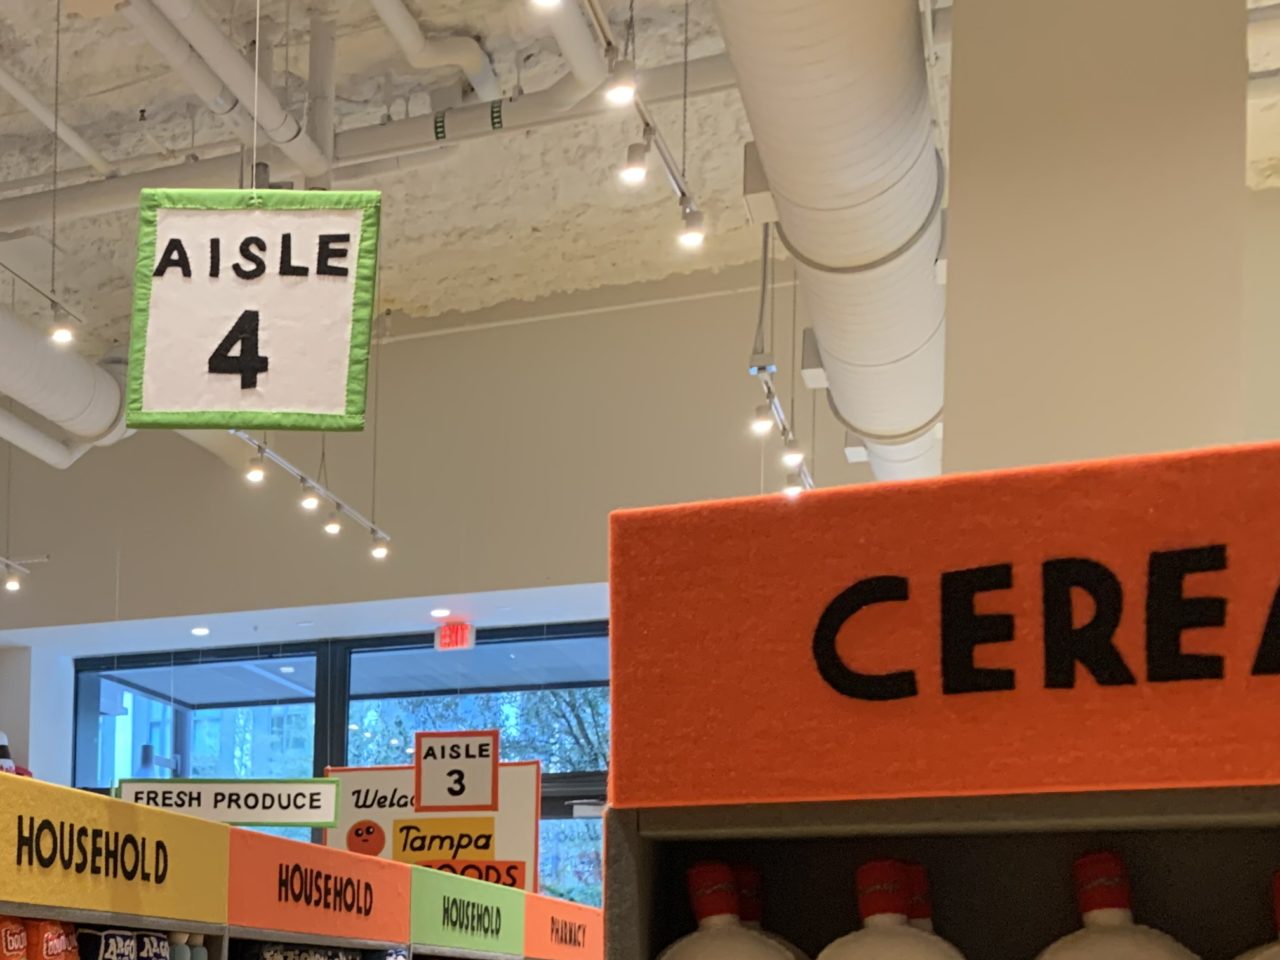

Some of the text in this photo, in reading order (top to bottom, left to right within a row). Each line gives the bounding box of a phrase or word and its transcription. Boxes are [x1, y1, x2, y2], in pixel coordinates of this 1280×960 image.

[153, 233, 350, 280] AISLE
[208, 309, 269, 390] 4
[439, 623, 470, 649] EXIT
[423, 743, 490, 760] AISLE
[446, 769, 465, 796] 3
[134, 790, 322, 810] FRESH PRODUCE
[17, 815, 168, 884] HOUSEHOLD
[399, 826, 492, 859] Tampa
[278, 863, 374, 917] HOUSEHOLD
[442, 895, 501, 935] HOUSEHOLD
[550, 916, 587, 947] PHARMACY
